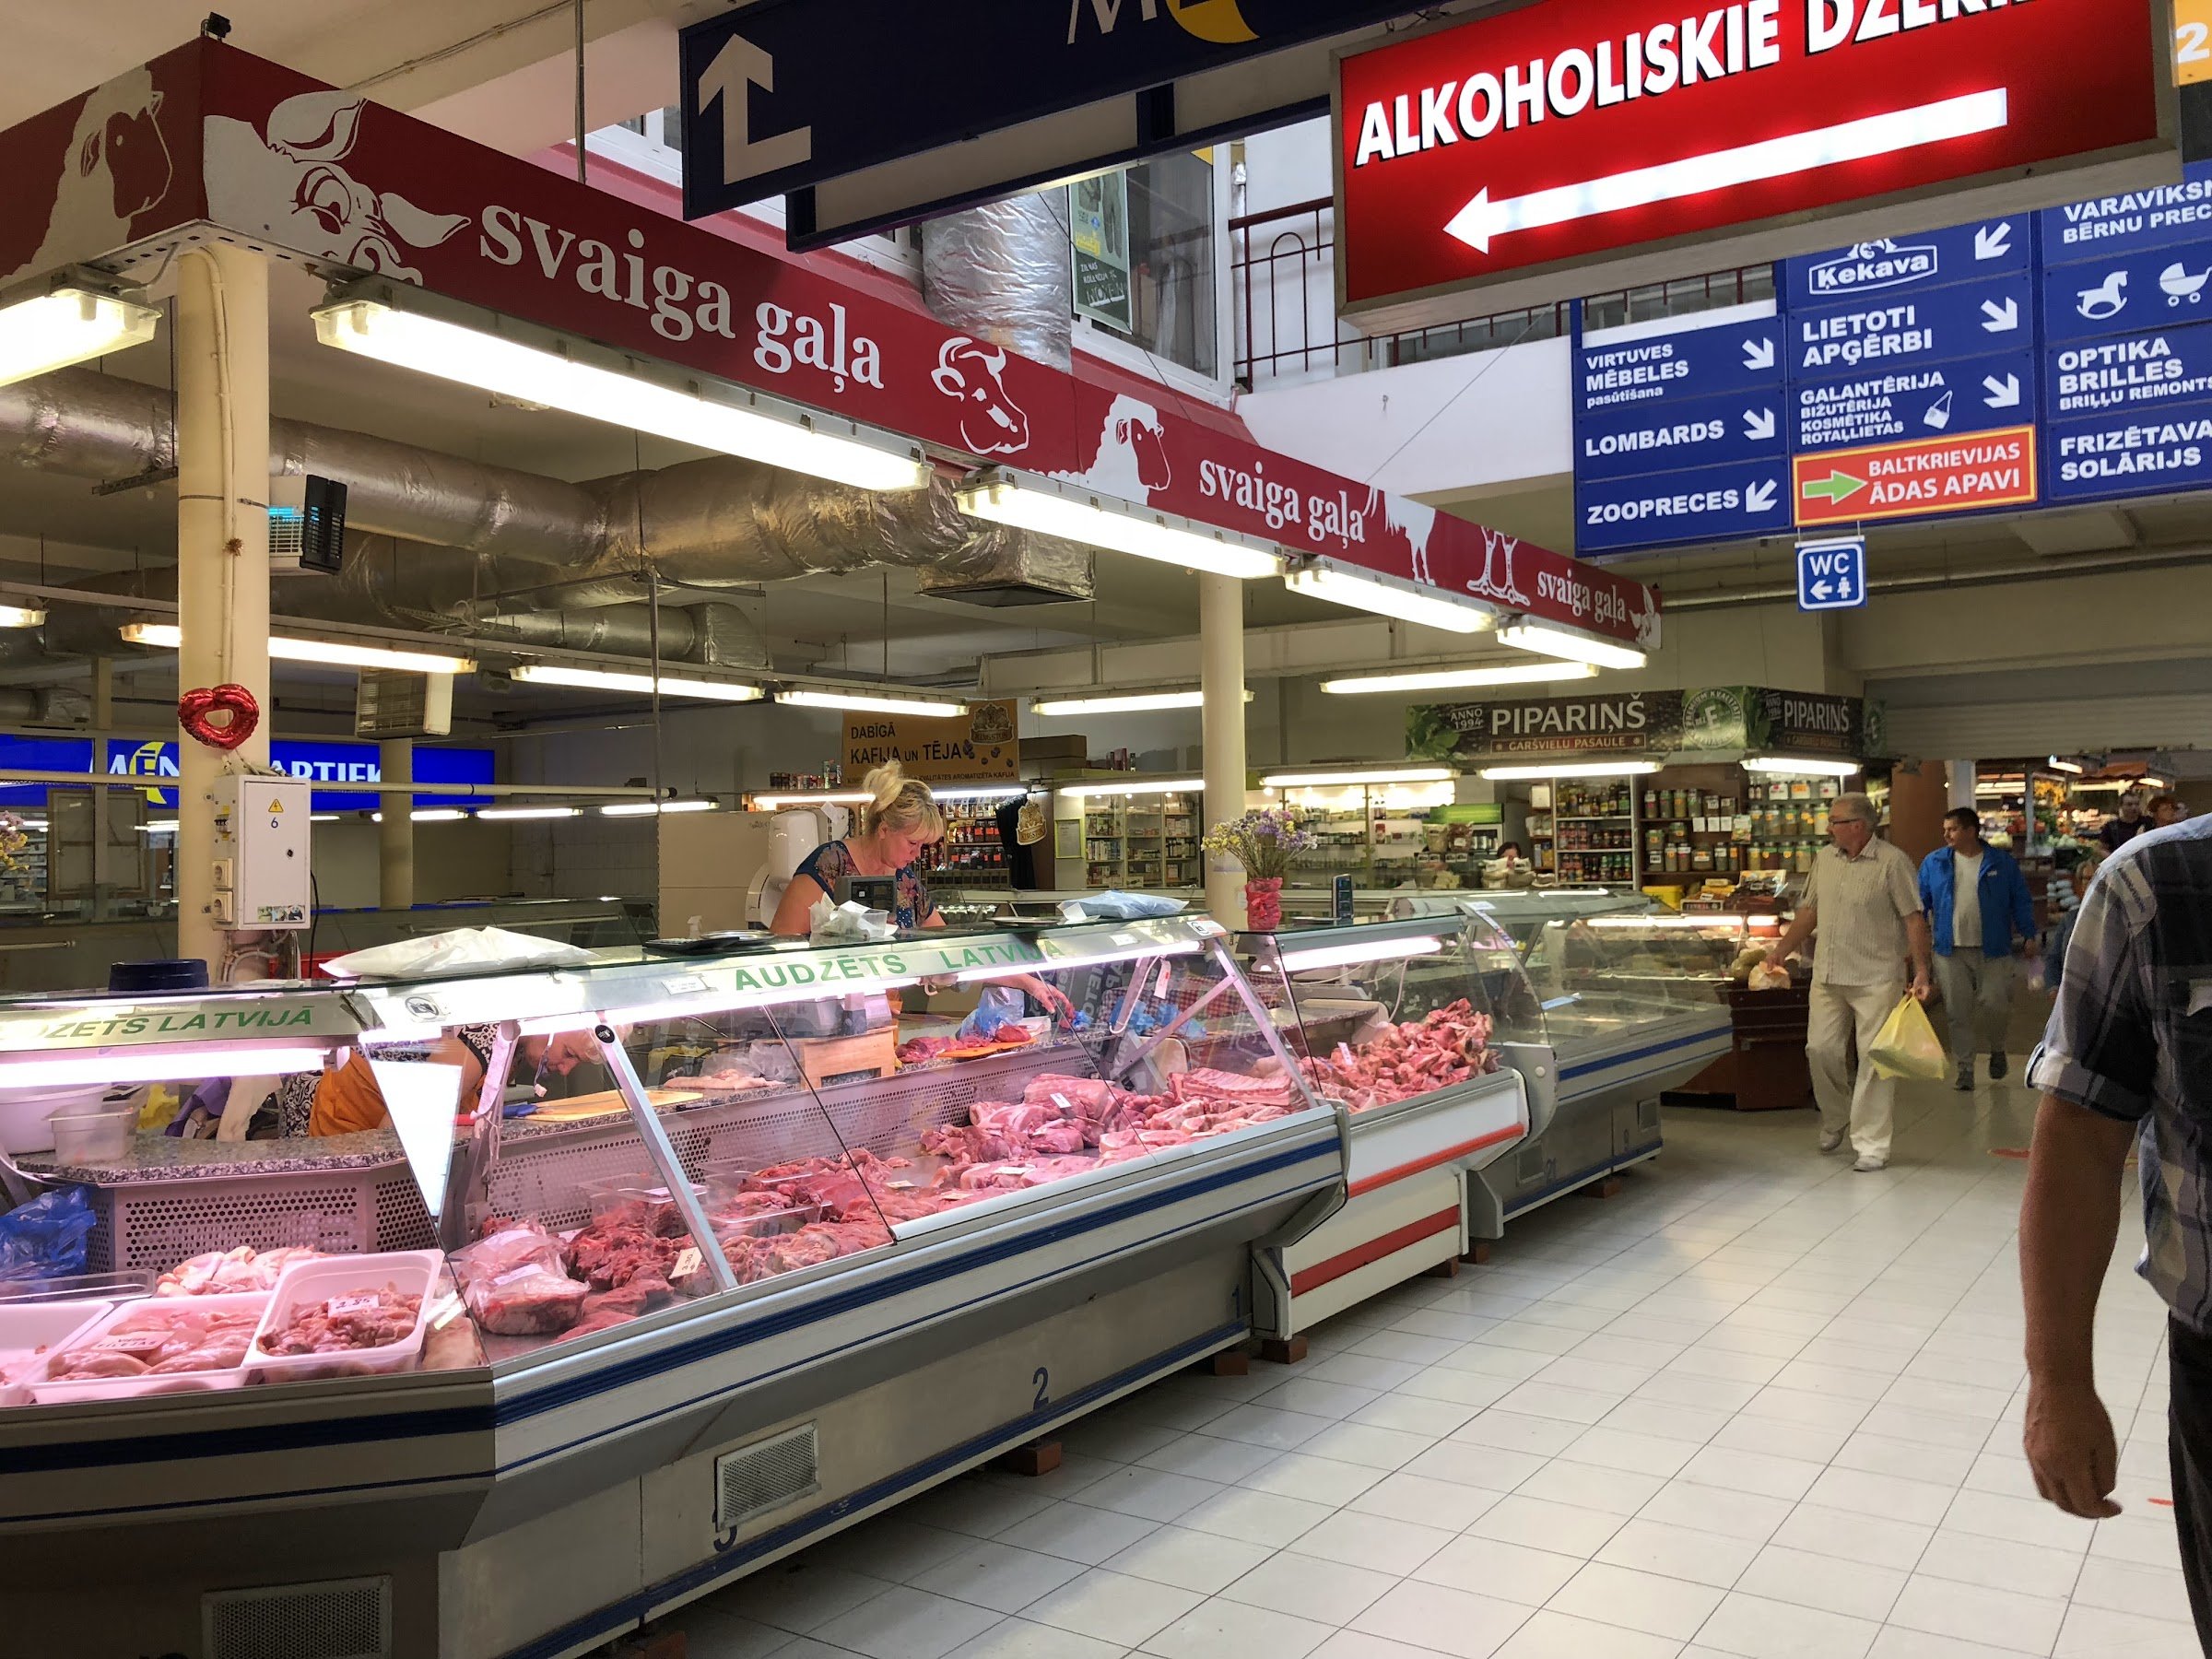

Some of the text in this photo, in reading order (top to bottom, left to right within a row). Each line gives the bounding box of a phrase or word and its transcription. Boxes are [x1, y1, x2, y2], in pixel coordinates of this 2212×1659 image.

[1354, 0, 1781, 167] ALKOHOLISKIE
[2064, 216, 2142, 243] BĒRNU
[1818, 254, 1929, 289] Ķekava
[479, 205, 884, 394] svaiga gaļa
[1803, 305, 1915, 342] LIETOTI
[1586, 344, 1673, 370] VIRTUVES
[1803, 328, 1933, 368] APĢĒRBI
[2058, 337, 2171, 371] OPTIKA
[1586, 360, 1689, 392] MĒBELES
[1800, 371, 1945, 406] GALANTĒRIJA
[2059, 359, 2183, 394] BRILLES
[1587, 386, 1664, 409] pasūtīšana
[1801, 396, 1892, 419] BIŽUTĒRIJA
[2059, 389, 2124, 410] BRIĻĻU
[1585, 420, 1724, 457] LOMBARDS
[1801, 410, 1892, 432] KOSMĒTIKA
[1801, 421, 1904, 445] ROTAĻLIETAS
[2061, 419, 2212, 456] FRIZĒTAVA
[1868, 442, 2020, 477] BALTKRIEVIJAS
[2061, 446, 2202, 481] SOLĀRIJS
[1869, 468, 2020, 505] ĀDAS APAVI
[1200, 460, 1365, 549] svaiga gaļa
[1587, 489, 1739, 524] ZOOPRECES
[1809, 552, 1850, 576] WC
[1537, 569, 1626, 628] svaiga gaļa
[851, 722, 896, 739] DABĪGĀ
[1451, 708, 1483, 722] ANNO
[1453, 718, 1484, 730] 1994
[1491, 692, 1646, 735] PIPARIŅŠ
[1784, 698, 1850, 734] PIPARIŅŠ
[851, 741, 961, 764] KAFIJA UN TĒJA
[1574, 737, 1626, 749] PASAULE
[270, 818, 278, 828] 6
[735, 953, 907, 991] AUDZĒTS
[157, 1006, 315, 1032] LATVIJĀ
[1032, 1366, 1049, 1411] 2
